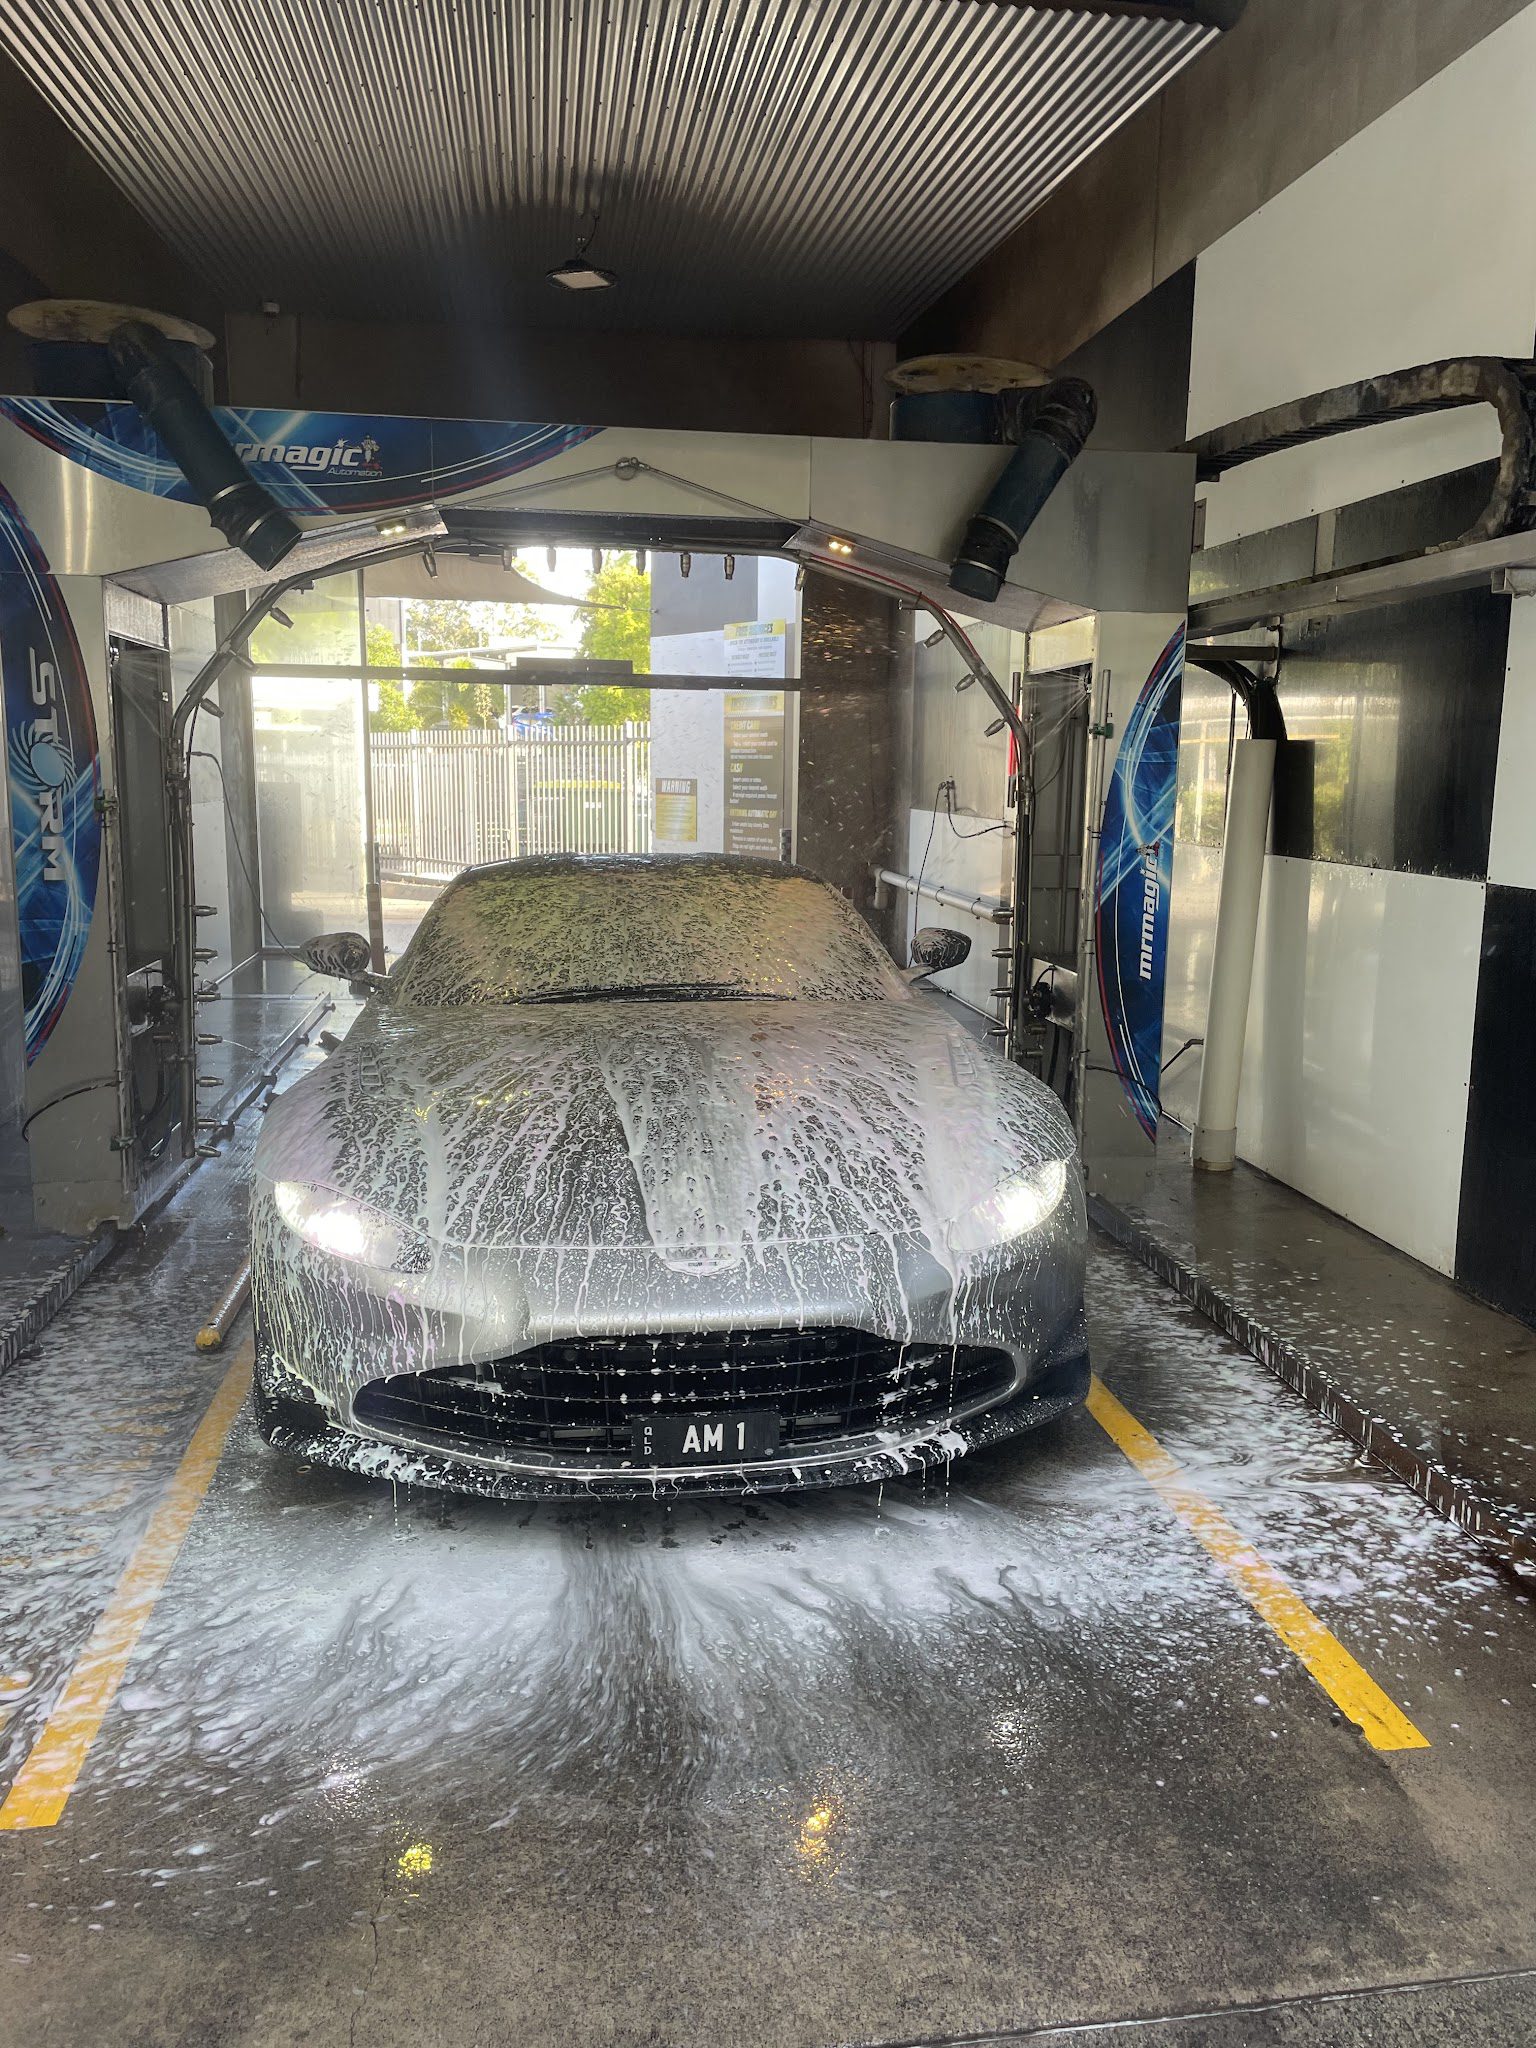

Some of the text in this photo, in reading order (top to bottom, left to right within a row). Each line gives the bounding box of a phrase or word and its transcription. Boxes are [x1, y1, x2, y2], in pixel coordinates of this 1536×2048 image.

[234, 438, 362, 471] rmagic
[327, 467, 383, 477] Automation
[661, 780, 690, 794] WARNING
[1139, 855, 1160, 980] mrmagic
[643, 1426, 653, 1455] QLD
[682, 1421, 745, 1453] AM 1
